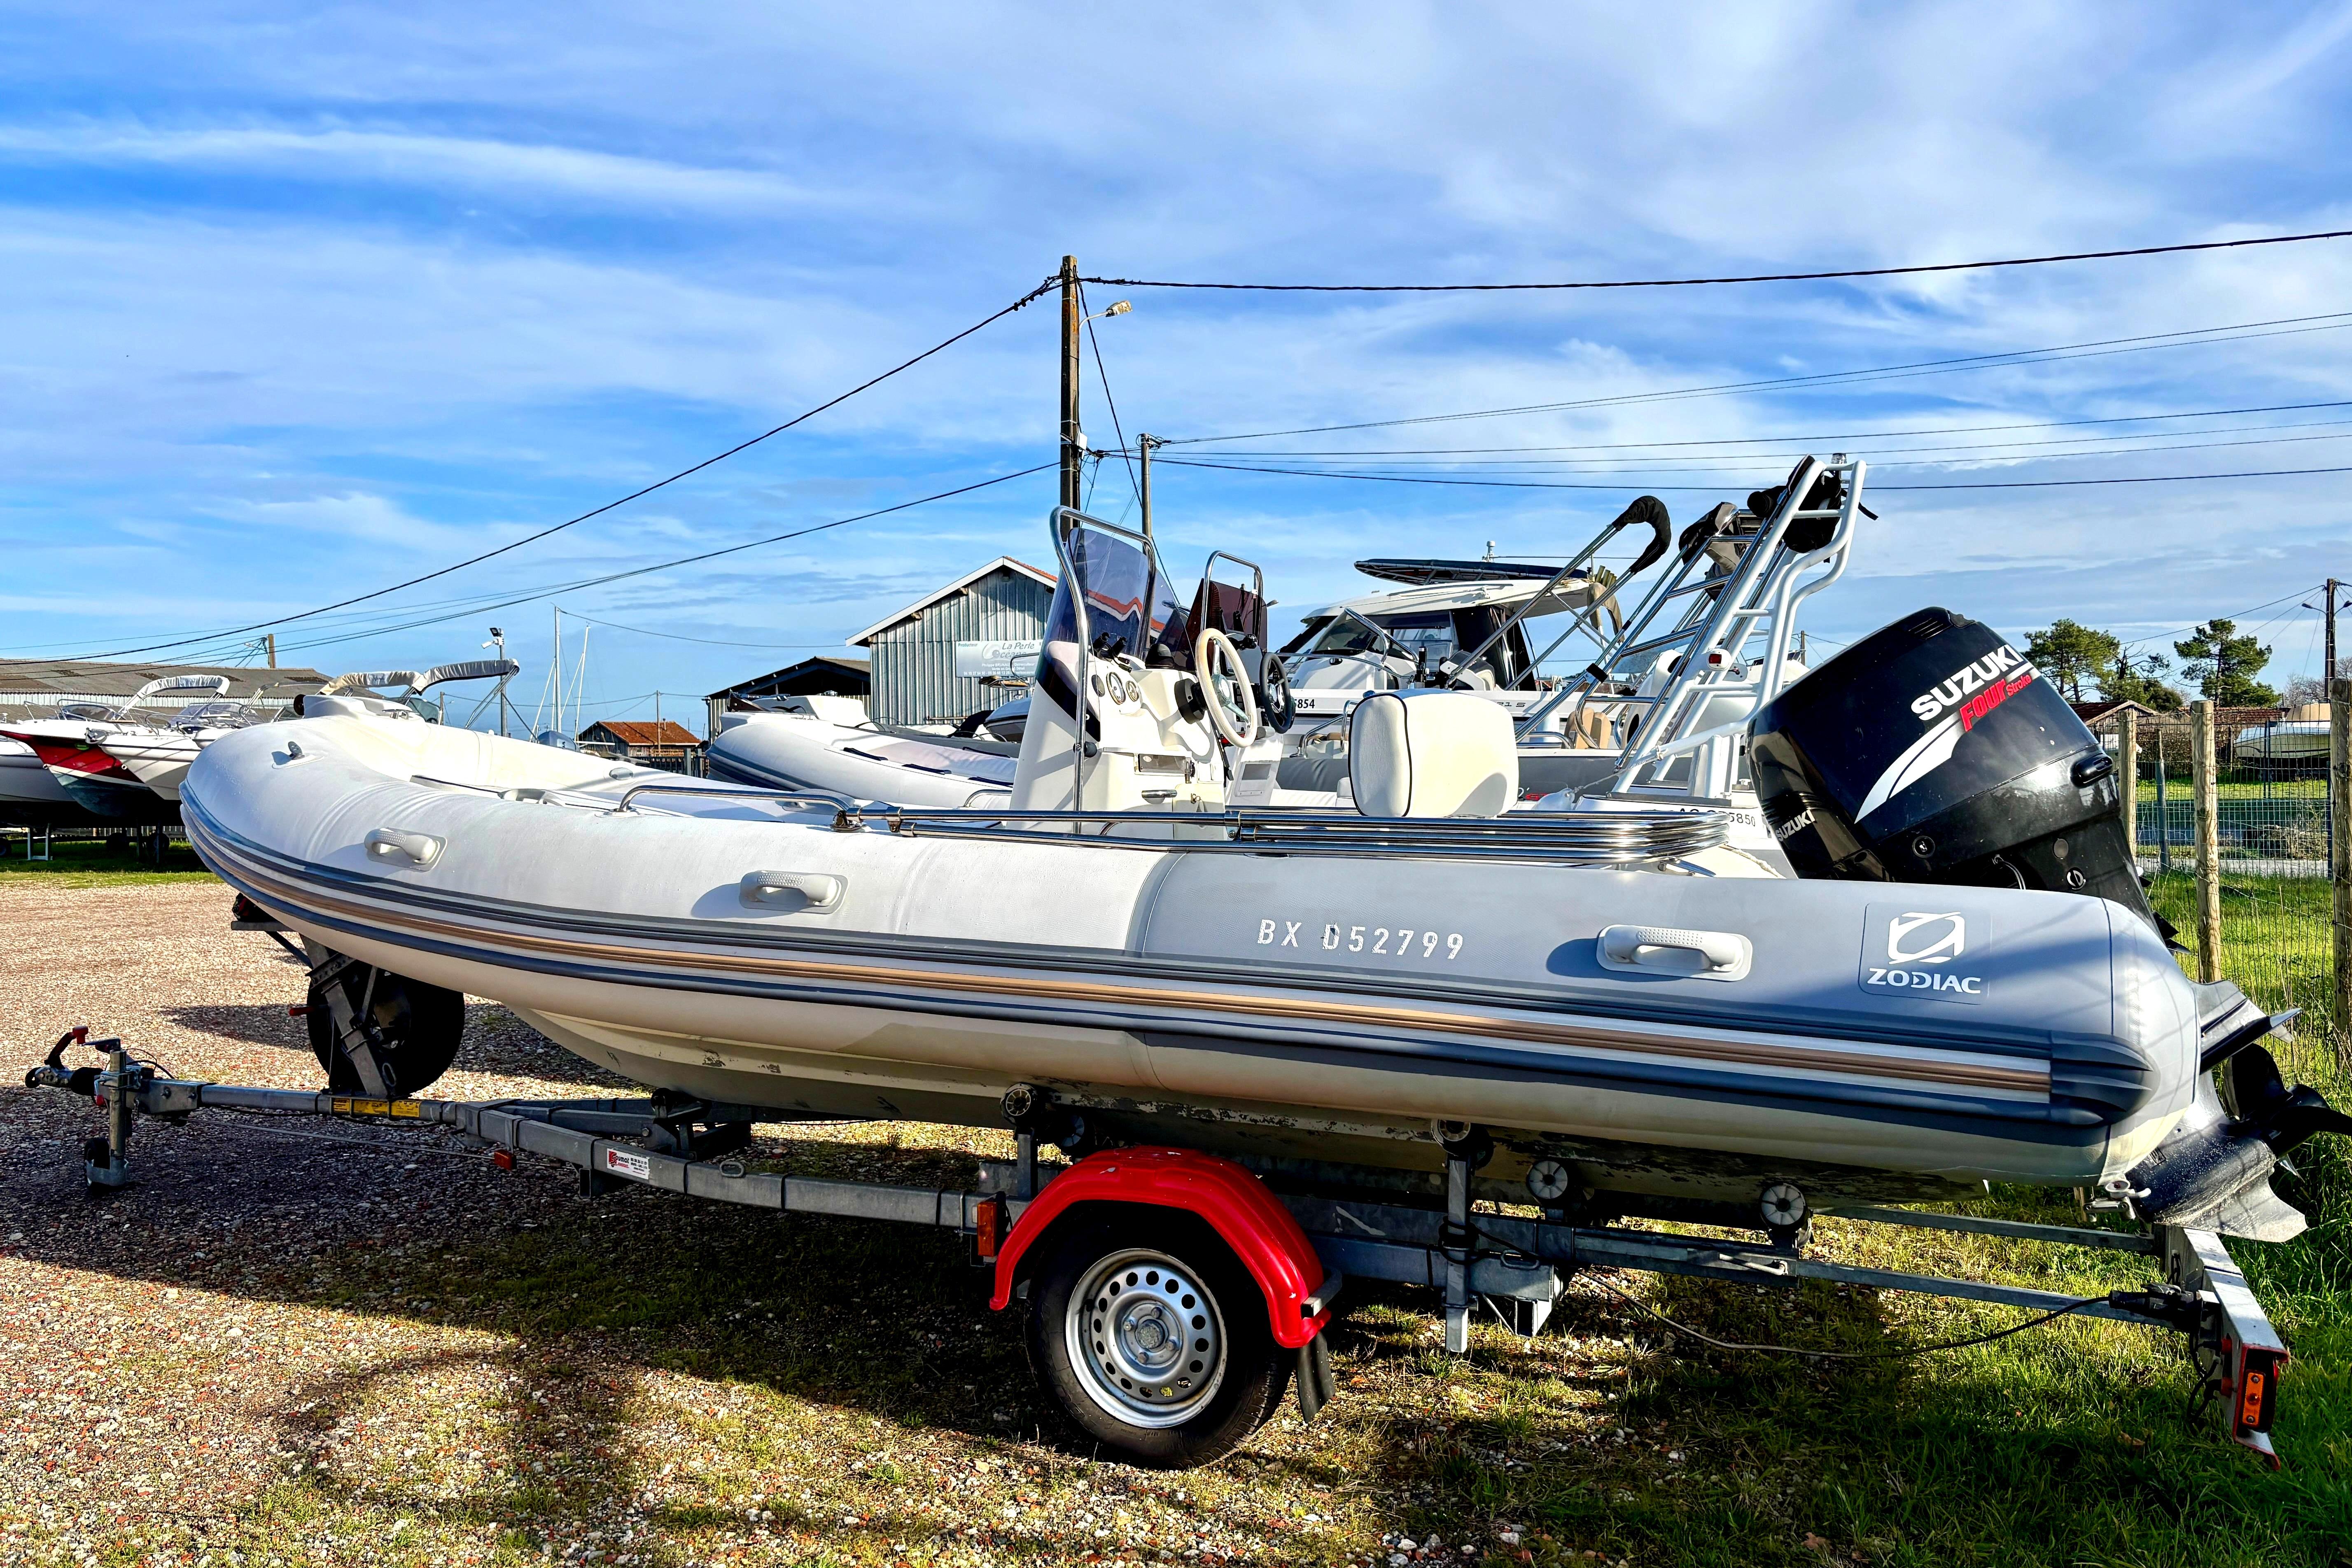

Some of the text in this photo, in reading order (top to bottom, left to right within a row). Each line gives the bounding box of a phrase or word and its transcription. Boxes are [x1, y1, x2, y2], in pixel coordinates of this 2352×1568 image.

[1911, 644, 2024, 721] SUZUKI
[1775, 809, 1815, 842] SUZUKI
[1257, 919, 1464, 960] BX D52799
[1867, 968, 1981, 994] ZODIAC
